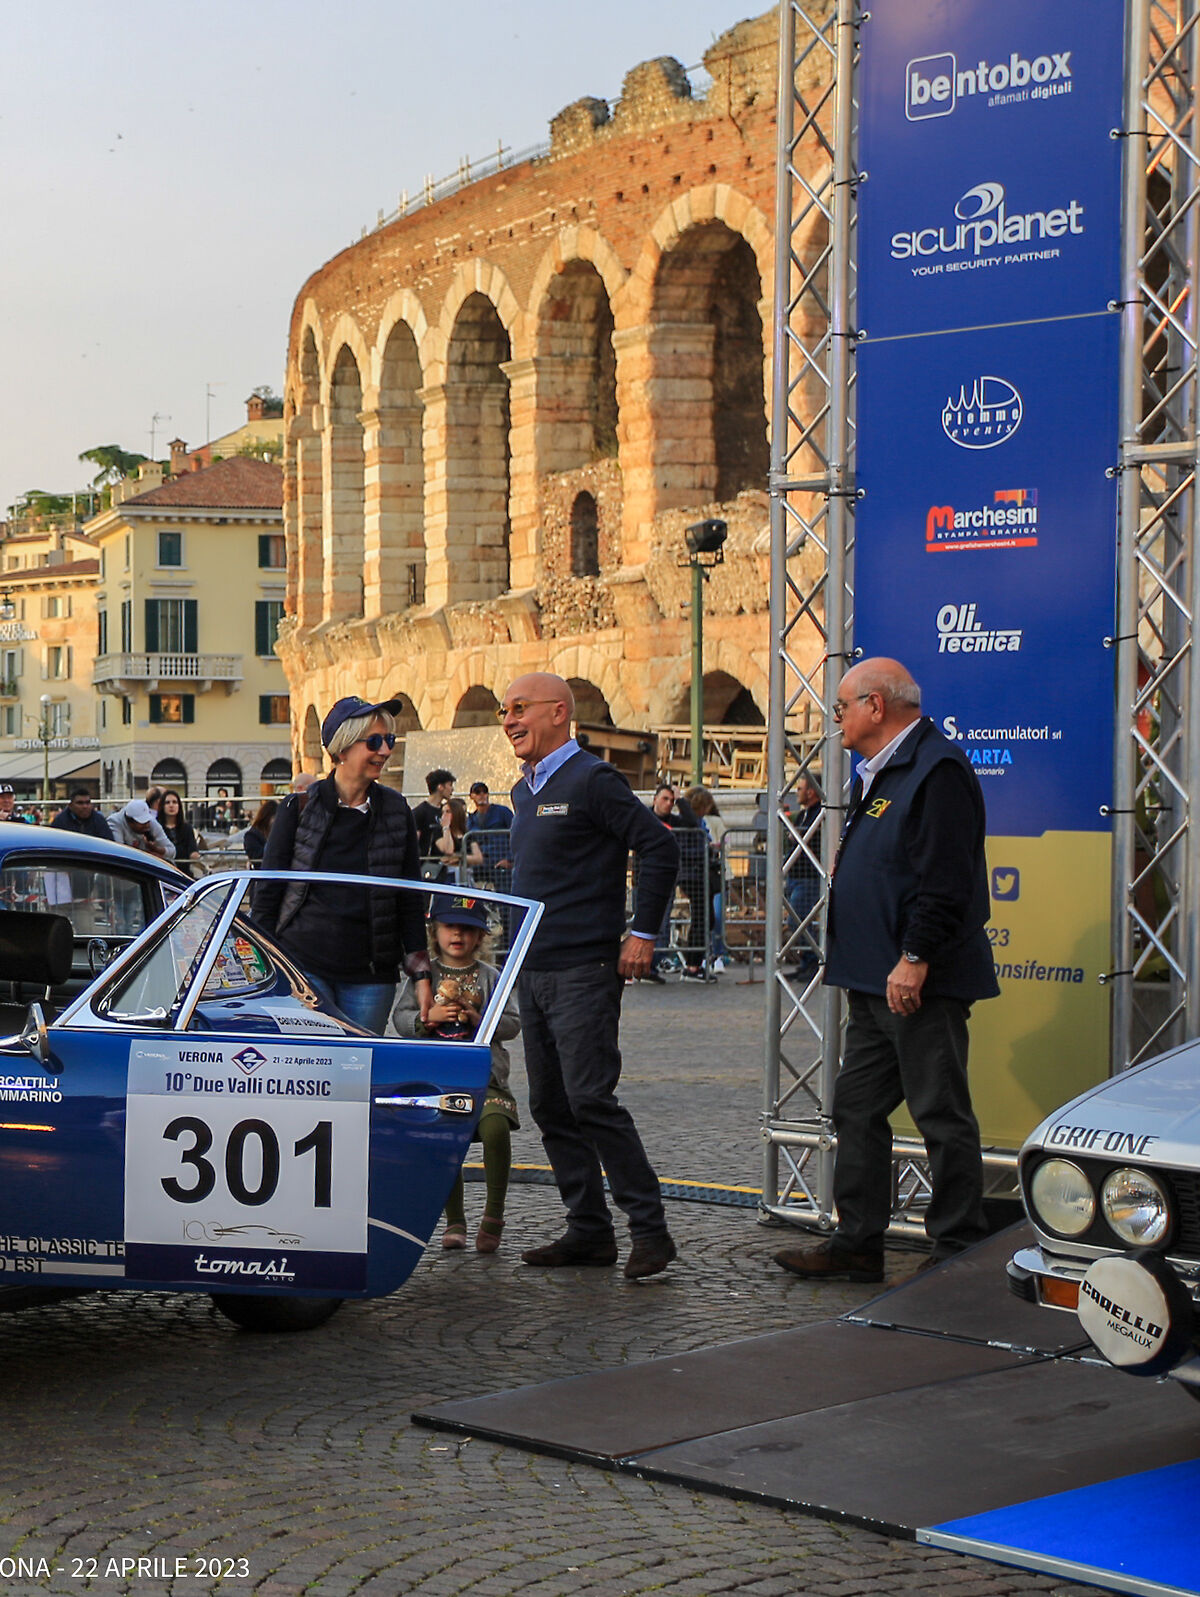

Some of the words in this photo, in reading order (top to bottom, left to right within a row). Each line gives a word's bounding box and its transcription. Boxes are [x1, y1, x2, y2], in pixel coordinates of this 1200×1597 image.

[910, 51, 1072, 106] bentobox
[1031, 81, 1072, 99] digitali
[911, 264, 944, 277] YOUR
[945, 257, 1002, 272] SECURITY
[1004, 248, 1060, 265] PARTNER
[951, 424, 1012, 438] events
[926, 505, 1038, 542] Marchesini
[937, 529, 979, 539] STAMPA
[990, 527, 1037, 536] GRAFICA
[938, 630, 1022, 653] Tecnica
[967, 725, 1049, 740] accumulatori
[178, 1051, 224, 1063] VERONA
[294, 1057, 315, 1066] Aprile
[316, 1058, 332, 1066] 2023
[193, 1076, 224, 1093] Due
[228, 1076, 263, 1094] Valli
[266, 1079, 332, 1096] CLASSIC
[1049, 1125, 1160, 1157] GRIFONE
[160, 1116, 333, 1209] 301
[26, 1237, 97, 1256] CLASSIC
[14, 1257, 47, 1274] EST
[194, 1253, 296, 1277] tomasi
[1081, 1280, 1163, 1340] CARELLO
[1106, 1318, 1153, 1350] MEGALUX
